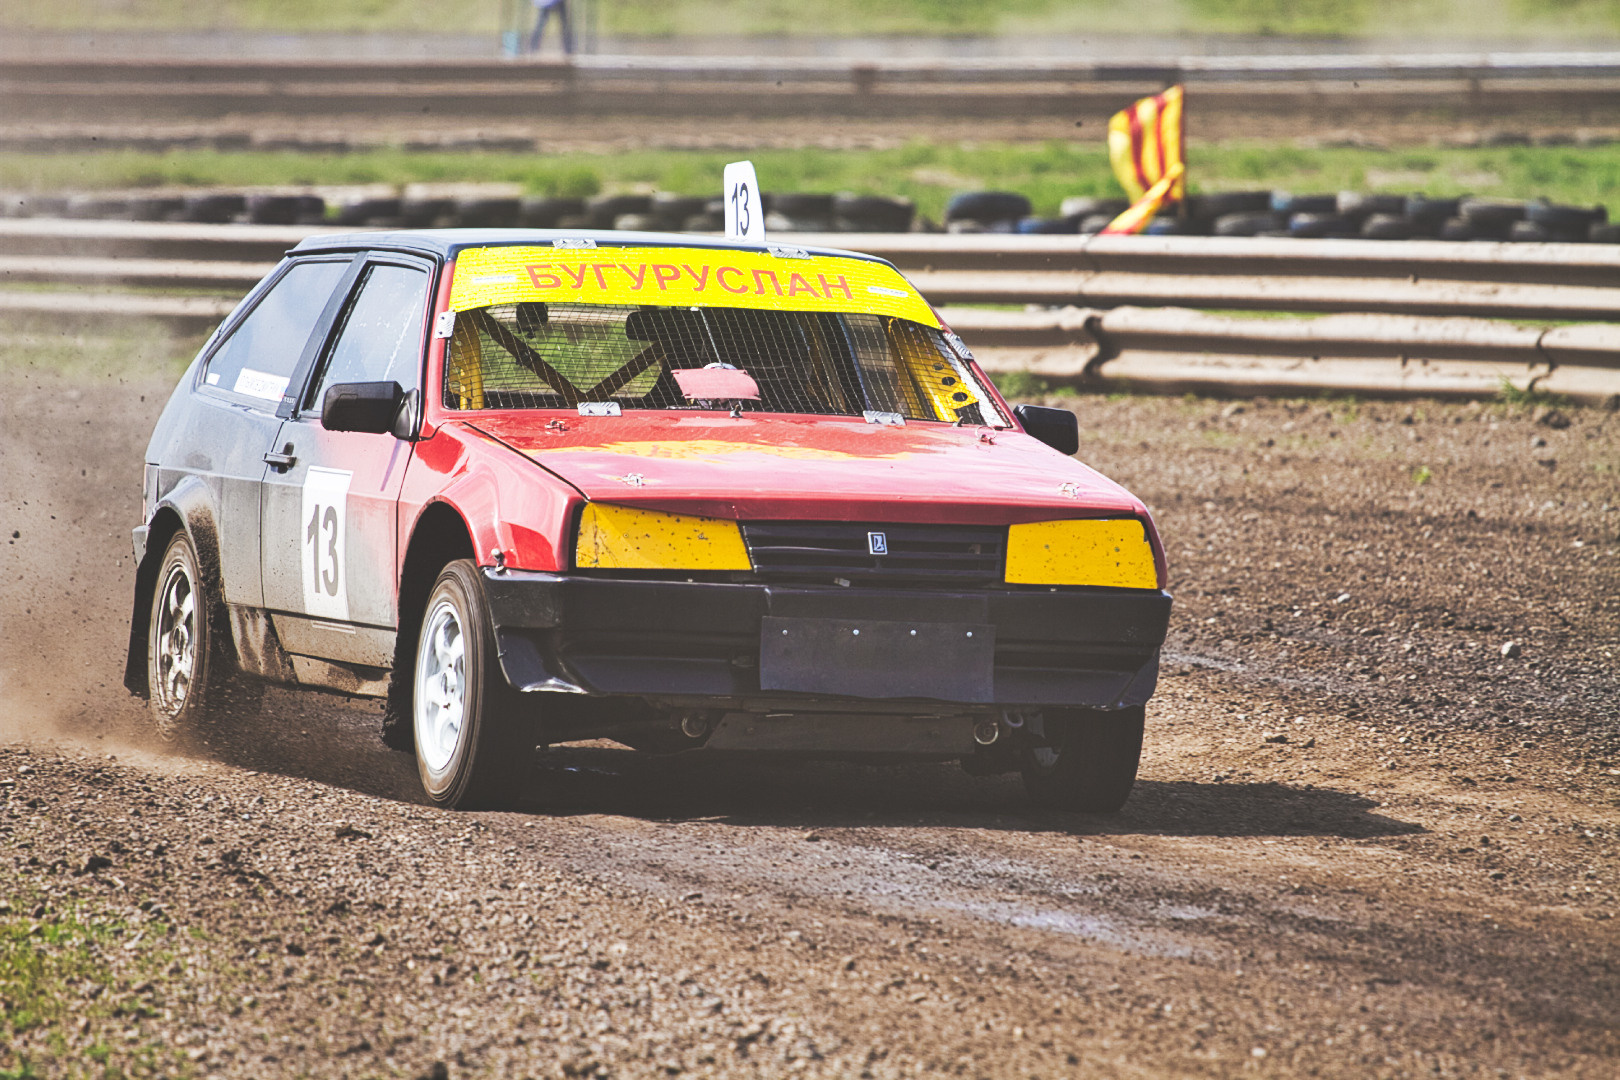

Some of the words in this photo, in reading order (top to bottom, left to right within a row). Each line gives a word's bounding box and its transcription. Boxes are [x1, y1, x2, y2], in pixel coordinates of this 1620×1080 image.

[732, 182, 749, 236] 13
[525, 263, 853, 299] БУГУРУСЛАН
[307, 504, 339, 597] 13
